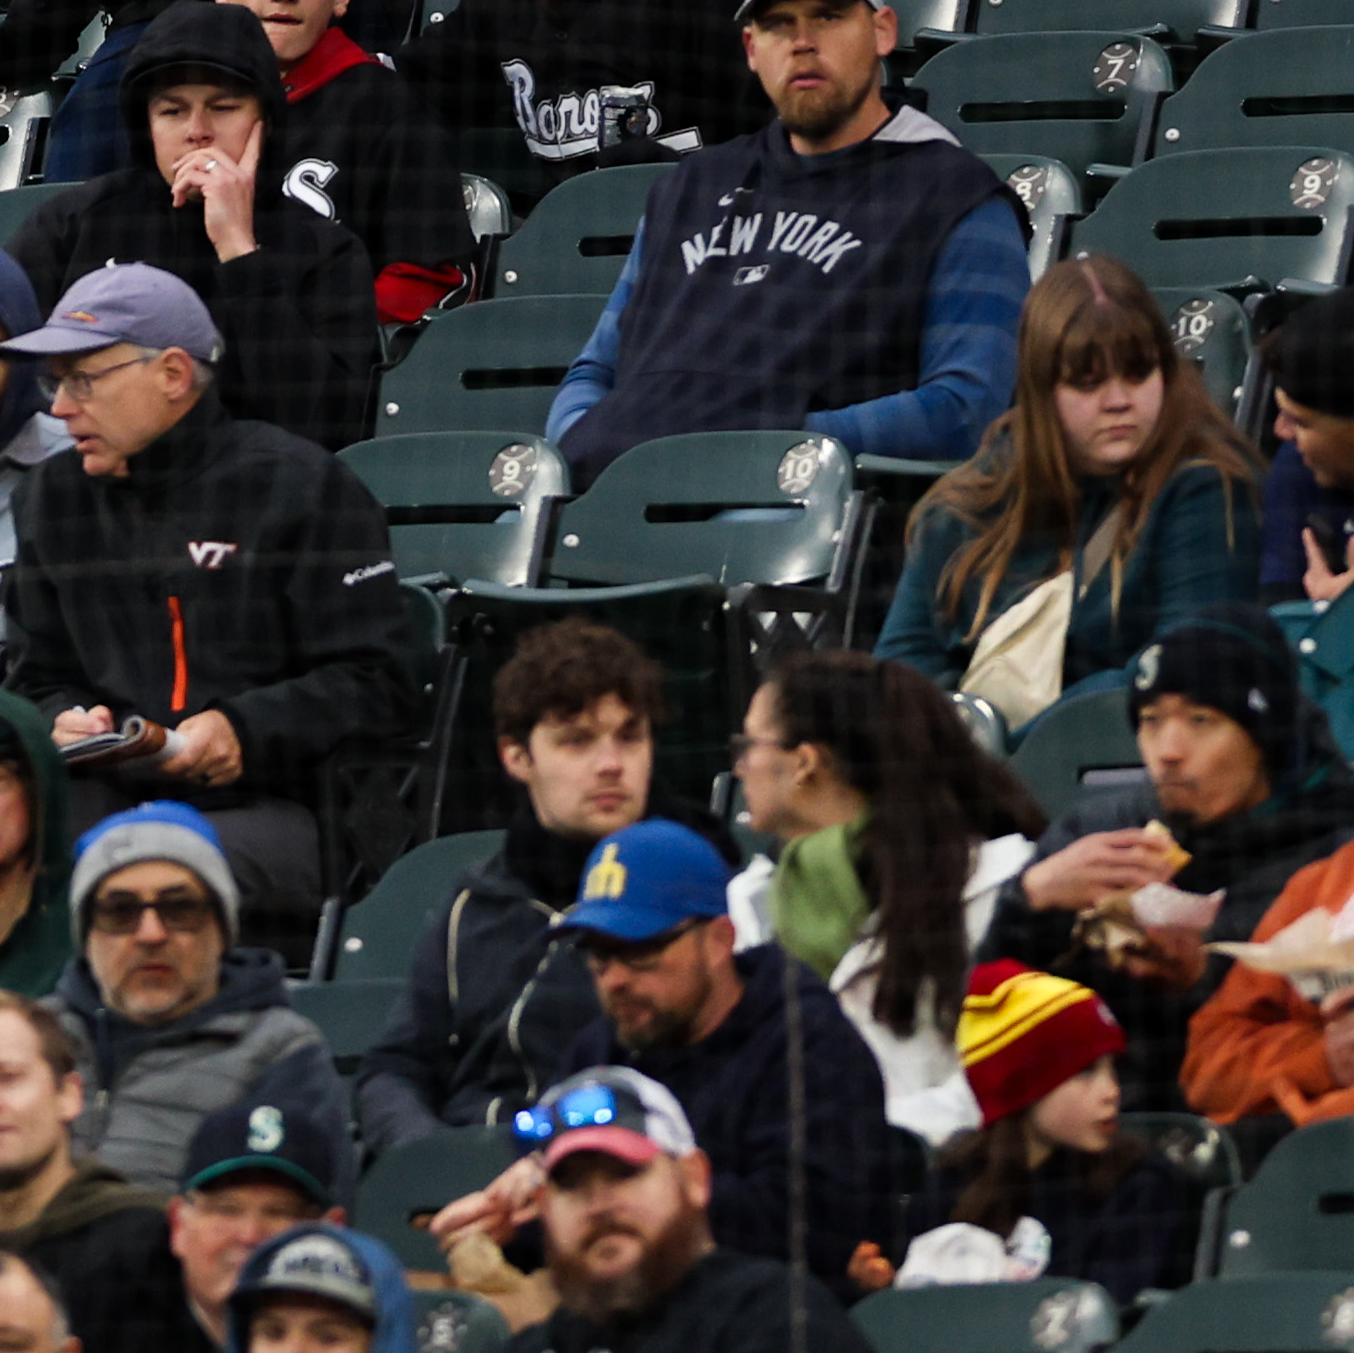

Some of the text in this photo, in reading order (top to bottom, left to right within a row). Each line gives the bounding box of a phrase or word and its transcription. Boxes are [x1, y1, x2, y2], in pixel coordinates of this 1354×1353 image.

[1109, 59, 1123, 78] 7
[1304, 175, 1319, 196] 9
[681, 211, 863, 275] NEW YORK
[1178, 315, 1207, 336] 10
[503, 460, 520, 480] 9
[785, 458, 813, 480] 10
[188, 542, 238, 569] VT
[248, 1105, 284, 1153] S
